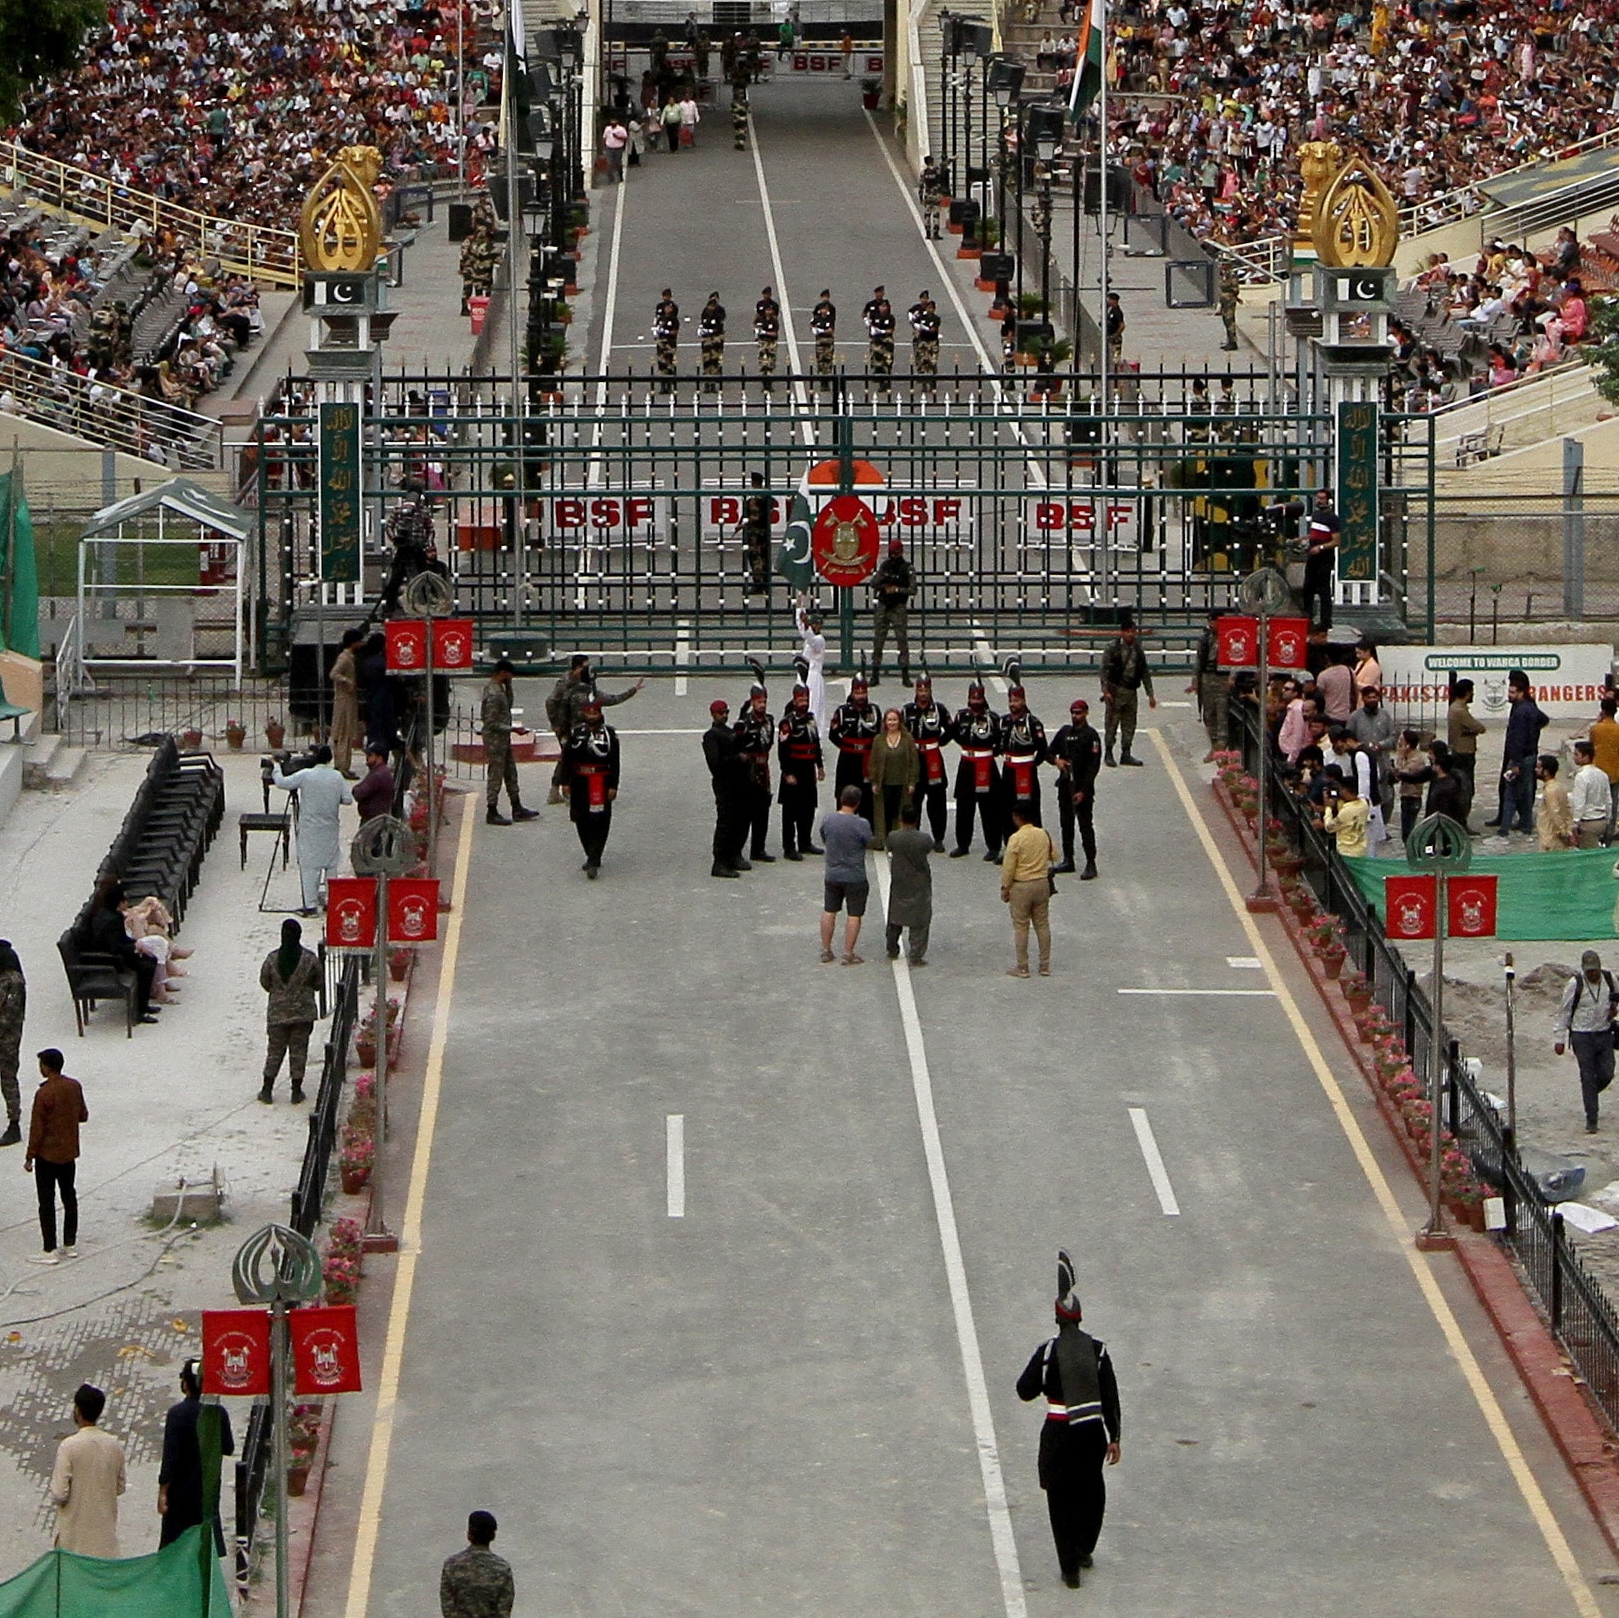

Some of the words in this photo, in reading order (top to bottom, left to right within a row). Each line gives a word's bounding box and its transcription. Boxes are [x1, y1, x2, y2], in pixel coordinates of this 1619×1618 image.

[793, 55, 842, 72] BSF
[555, 499, 652, 528] BSF
[1036, 503, 1133, 531] BSF
[1428, 657, 1472, 667] WELCOME
[1473, 657, 1485, 667] TO
[1521, 657, 1558, 667] BORDER
